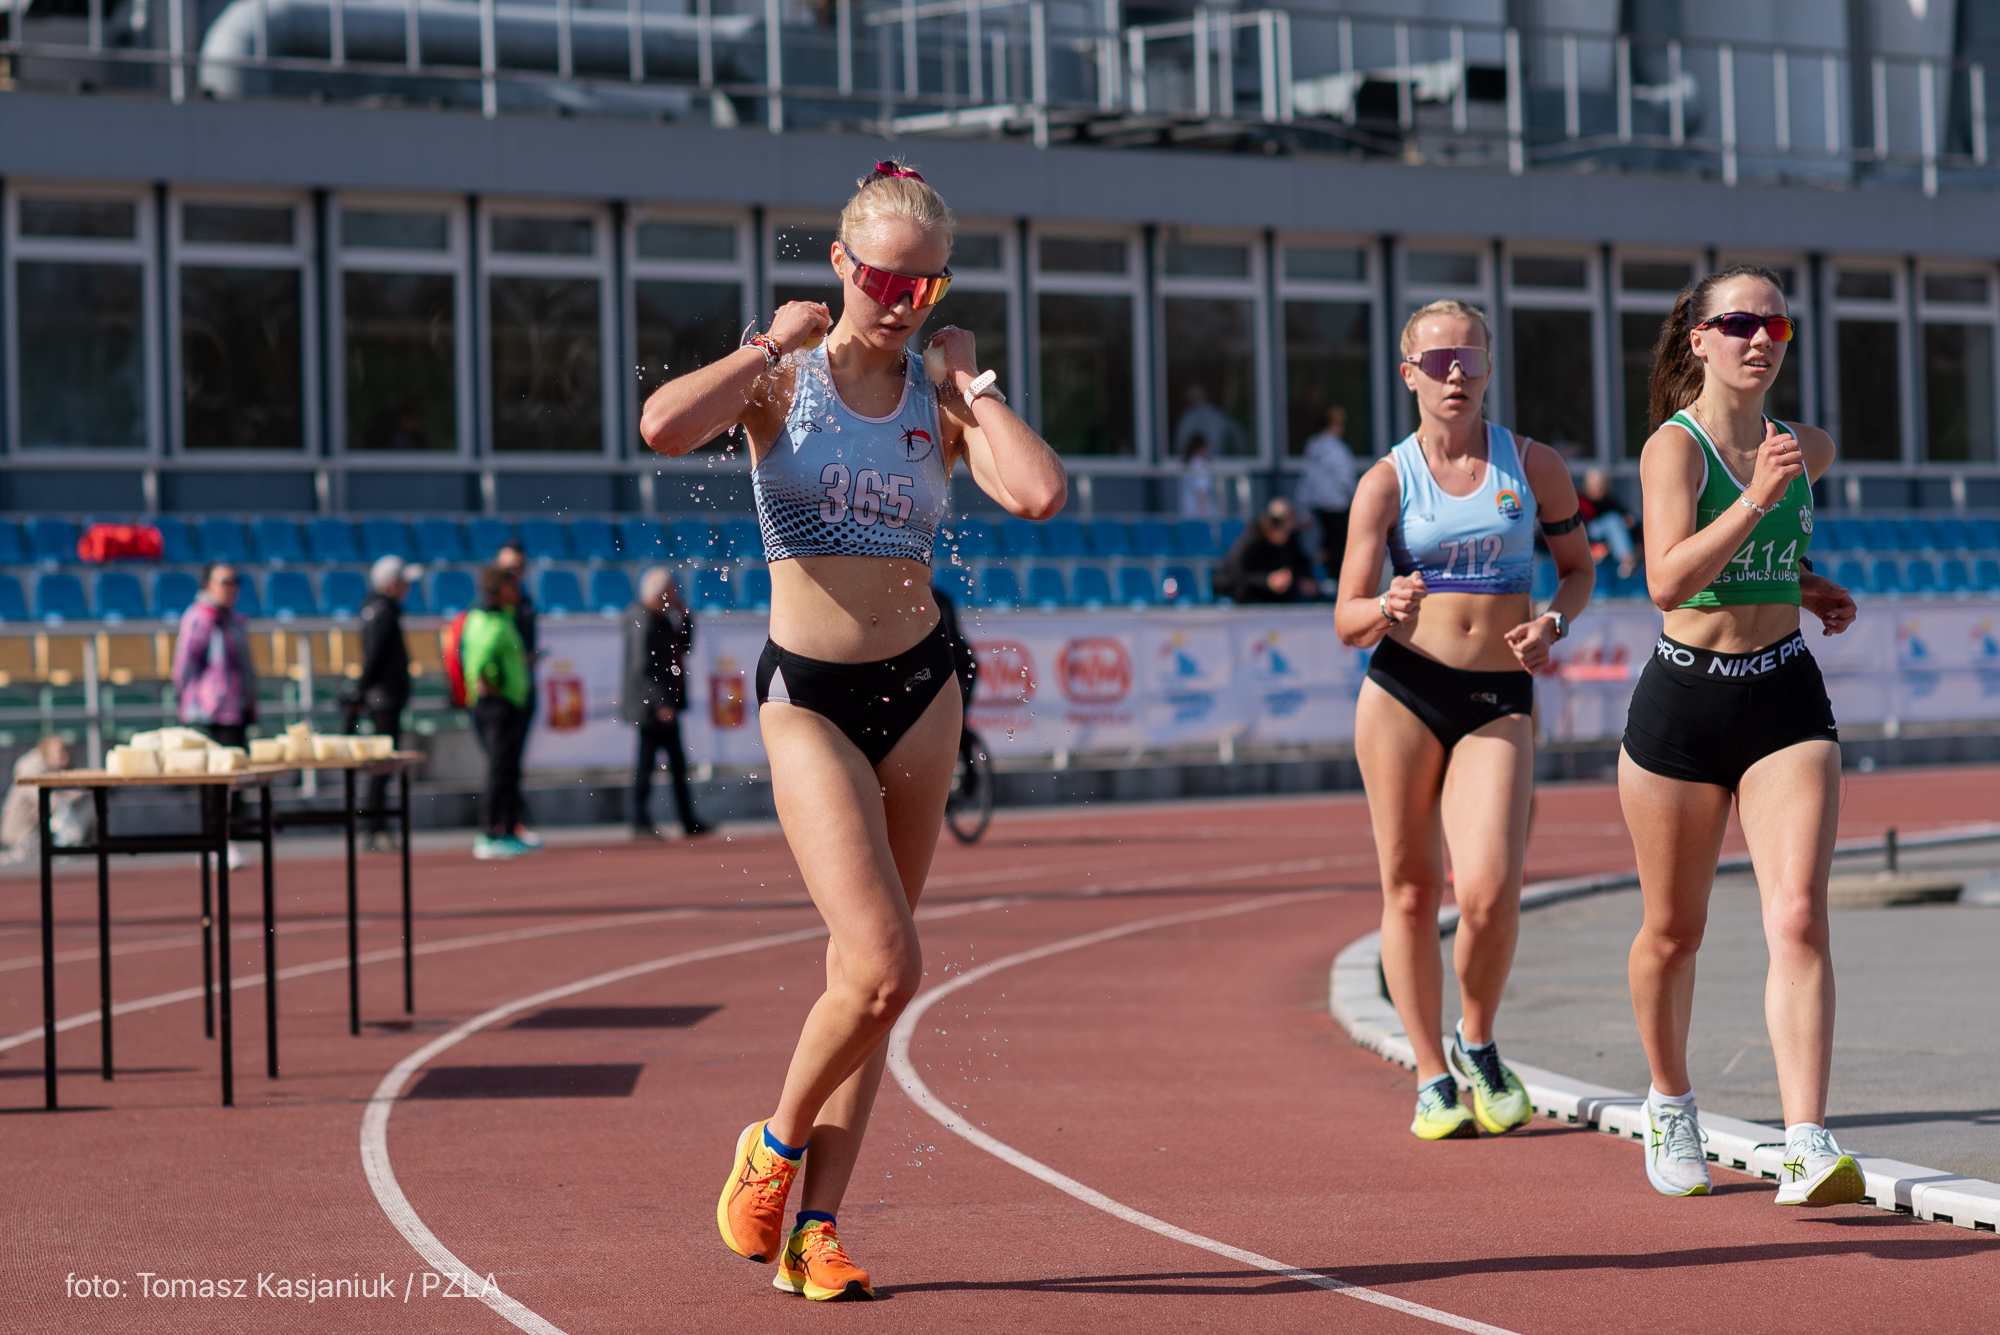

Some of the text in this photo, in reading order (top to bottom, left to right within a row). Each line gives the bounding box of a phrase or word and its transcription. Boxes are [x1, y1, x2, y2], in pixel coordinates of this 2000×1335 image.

[818, 463, 914, 529] 365
[1440, 535, 1504, 579] 712
[1731, 539, 1797, 571] 414
[1736, 569, 1771, 582] UMCS
[1707, 650, 1777, 677] NIKE
[1779, 636, 1806, 665] PR
